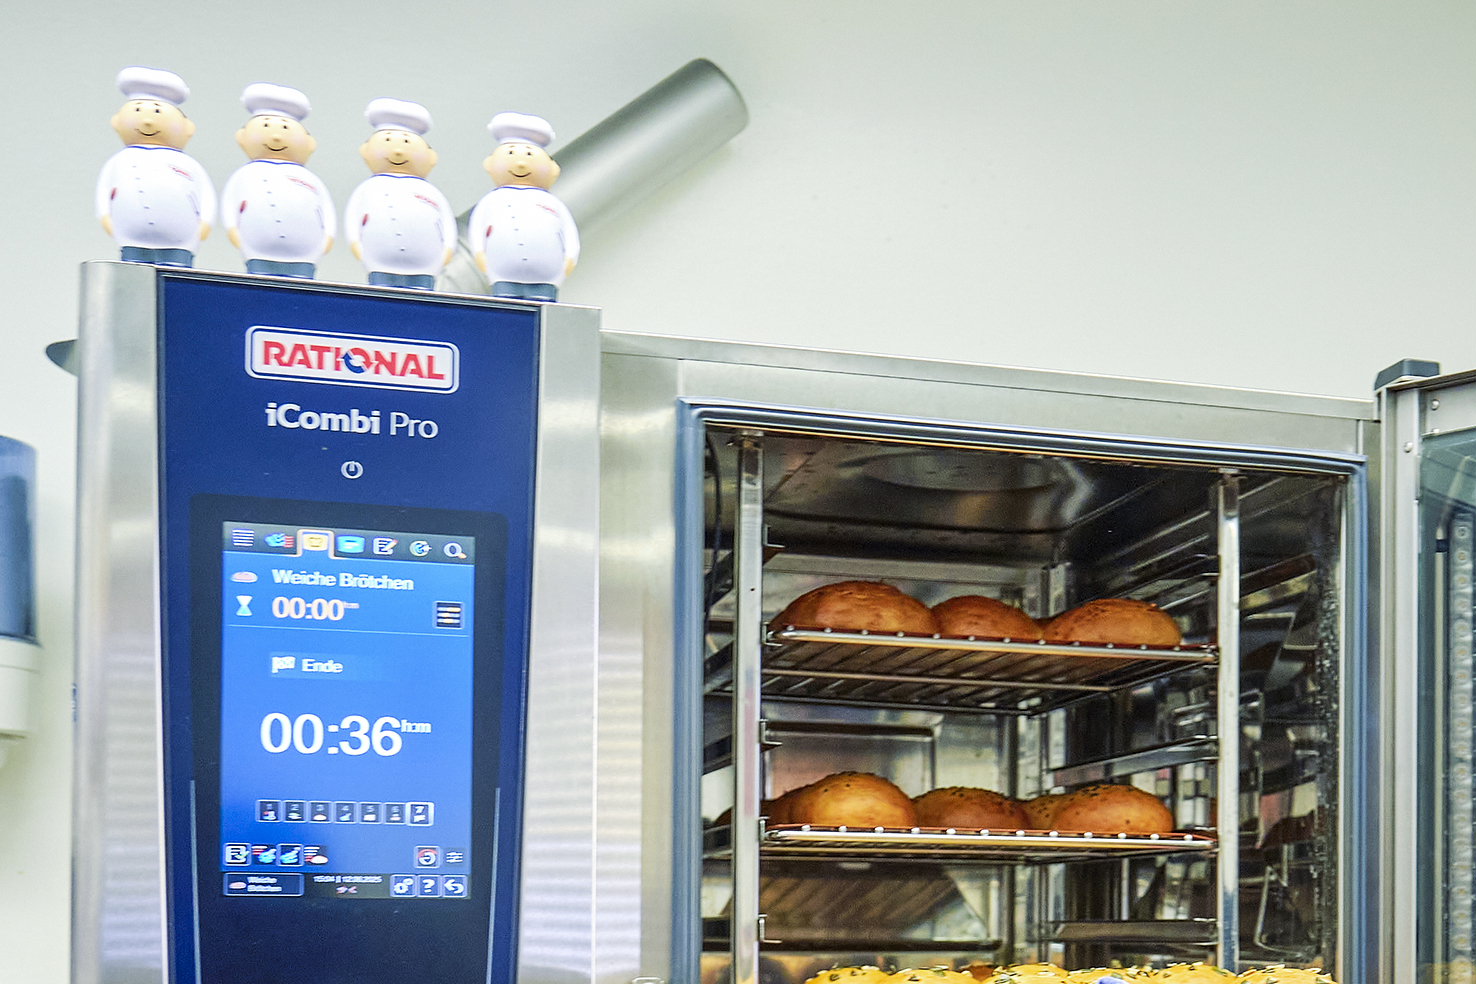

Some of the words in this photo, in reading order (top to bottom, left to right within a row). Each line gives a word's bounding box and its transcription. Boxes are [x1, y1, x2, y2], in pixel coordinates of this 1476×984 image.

[263, 340, 446, 381] RATIONAL
[265, 402, 381, 435] iCombi
[389, 411, 439, 439] Pro
[271, 568, 337, 587] Weiche
[339, 571, 414, 591] Brötchen
[271, 596, 345, 621] 00:00
[301, 658, 343, 674] Ende
[260, 712, 403, 757] 00:36
